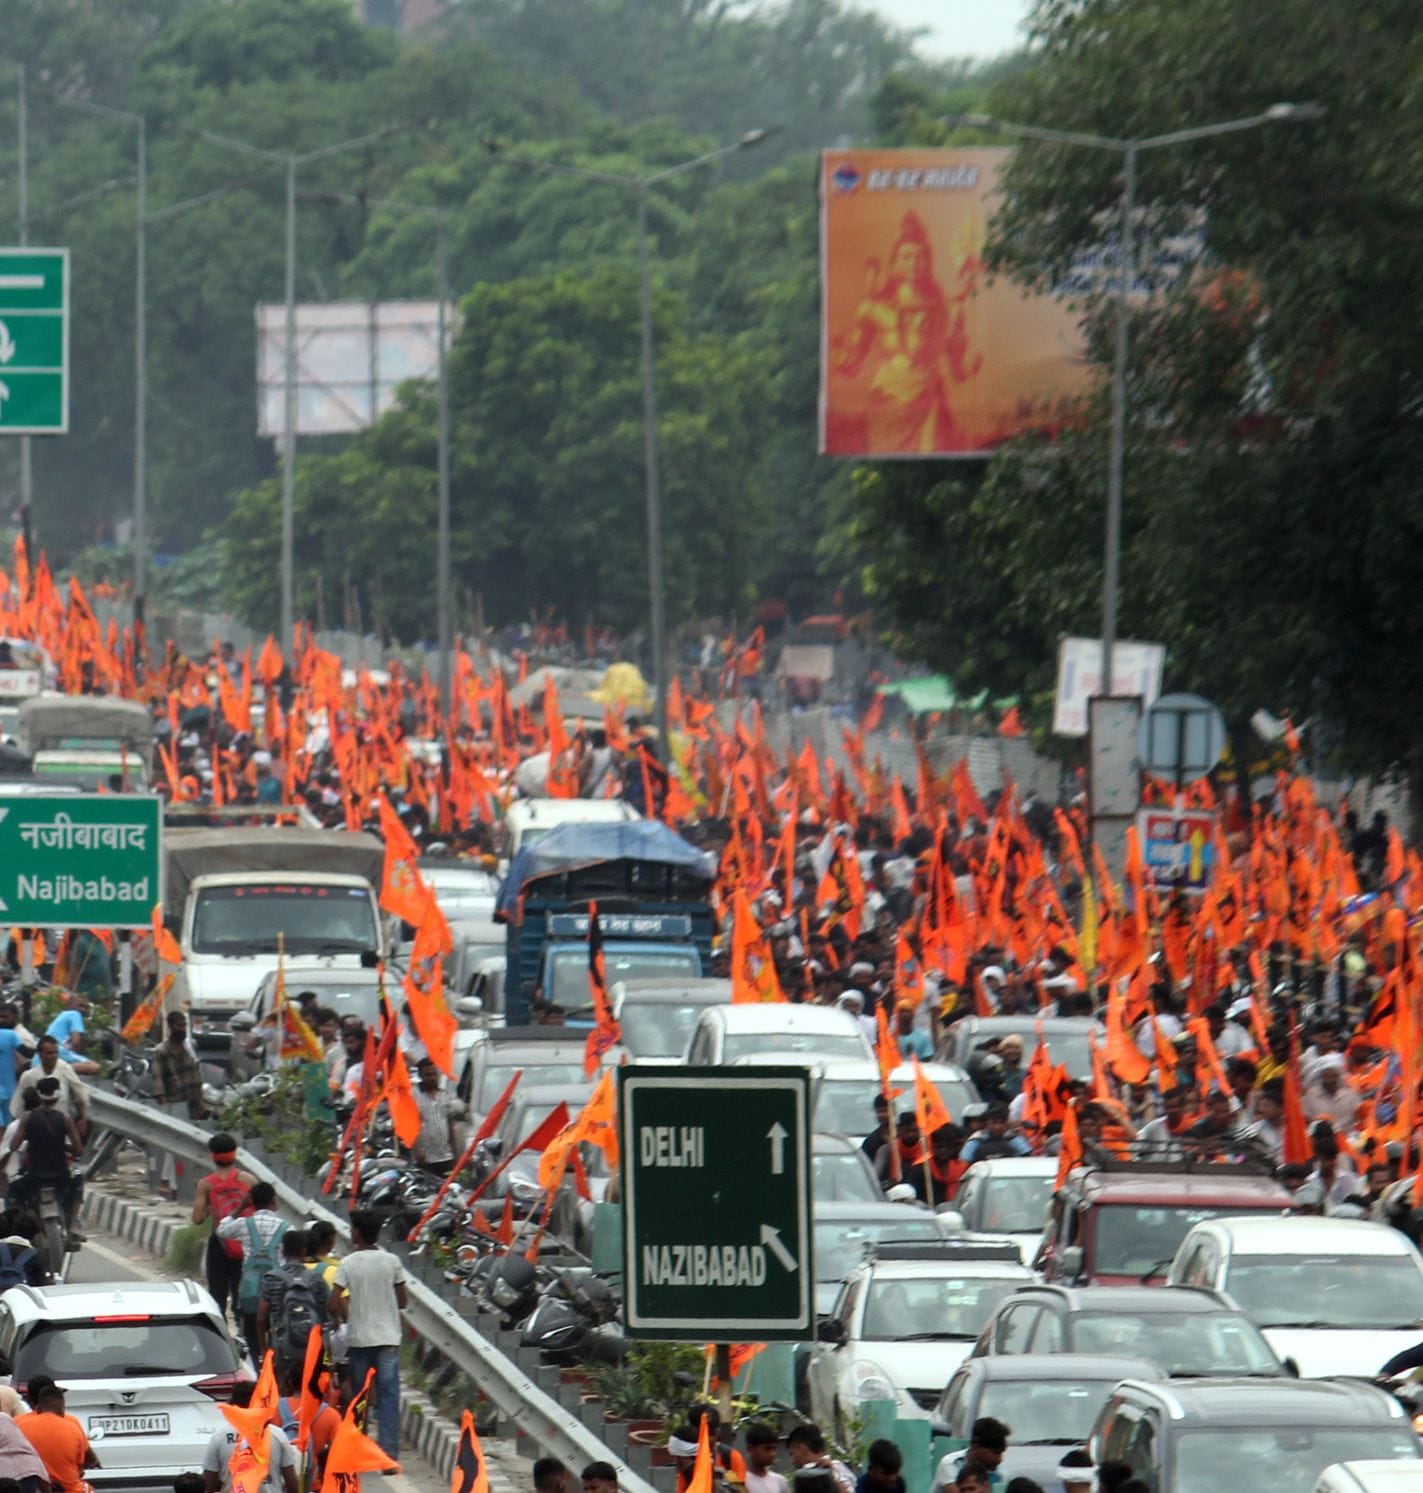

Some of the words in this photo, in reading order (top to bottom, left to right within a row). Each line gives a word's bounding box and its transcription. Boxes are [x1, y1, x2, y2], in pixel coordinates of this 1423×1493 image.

[18, 812, 148, 850] नजीबाबाद
[17, 874, 149, 905] Najibabad
[640, 1126, 704, 1167] DELHI
[642, 1244, 767, 1287] NAZIBABAD
